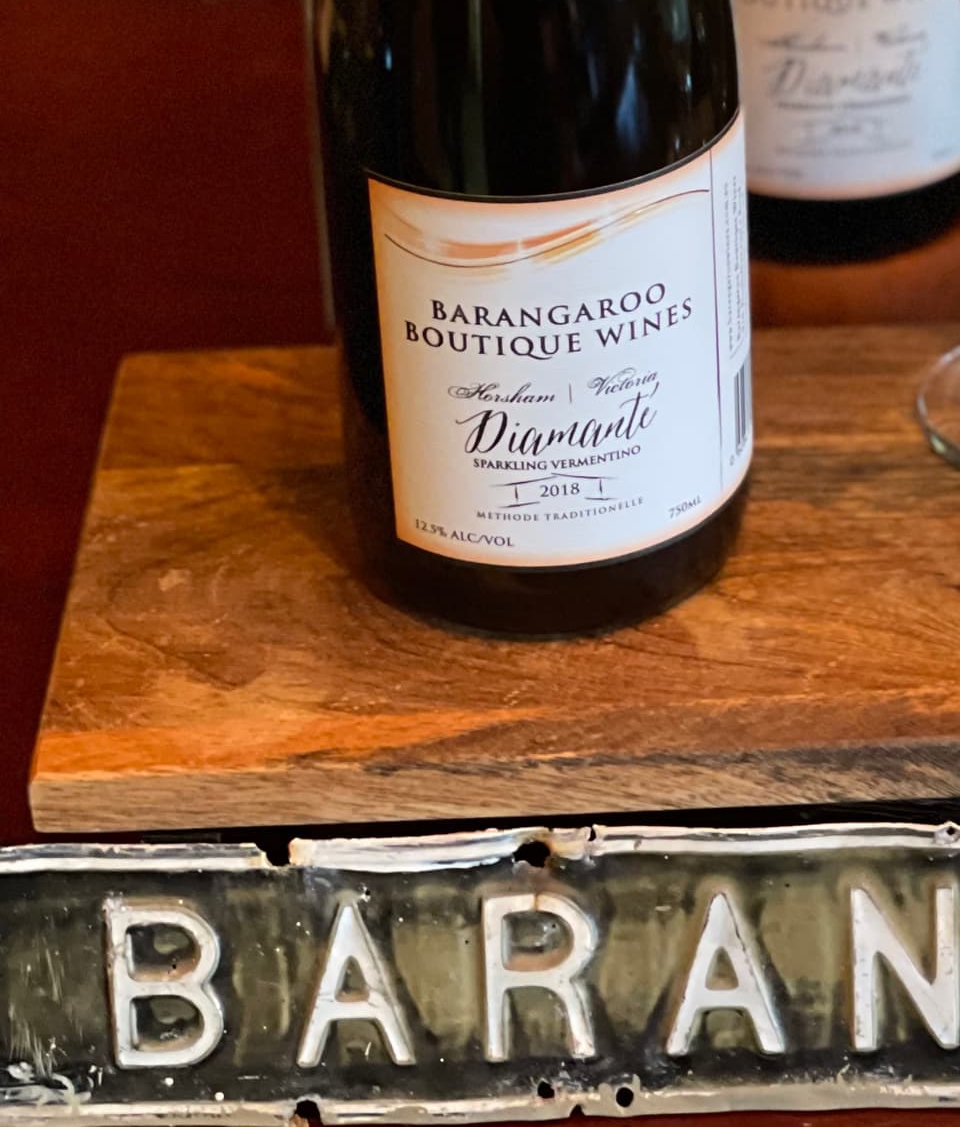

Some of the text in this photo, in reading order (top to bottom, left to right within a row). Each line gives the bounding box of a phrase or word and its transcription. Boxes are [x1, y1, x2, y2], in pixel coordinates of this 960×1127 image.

[431, 282, 666, 328] BARANGAROO
[405, 297, 693, 361] BOUTIQUE WINES
[448, 367, 659, 404] Horsham Victoria
[455, 381, 660, 457] Diamante
[472, 445, 642, 472] SPARKLING VERMENTINO
[539, 482, 580, 498] 2018
[476, 496, 644, 522] METHODE TRADITIONELLE
[450, 529, 515, 548] ALC/VOL
